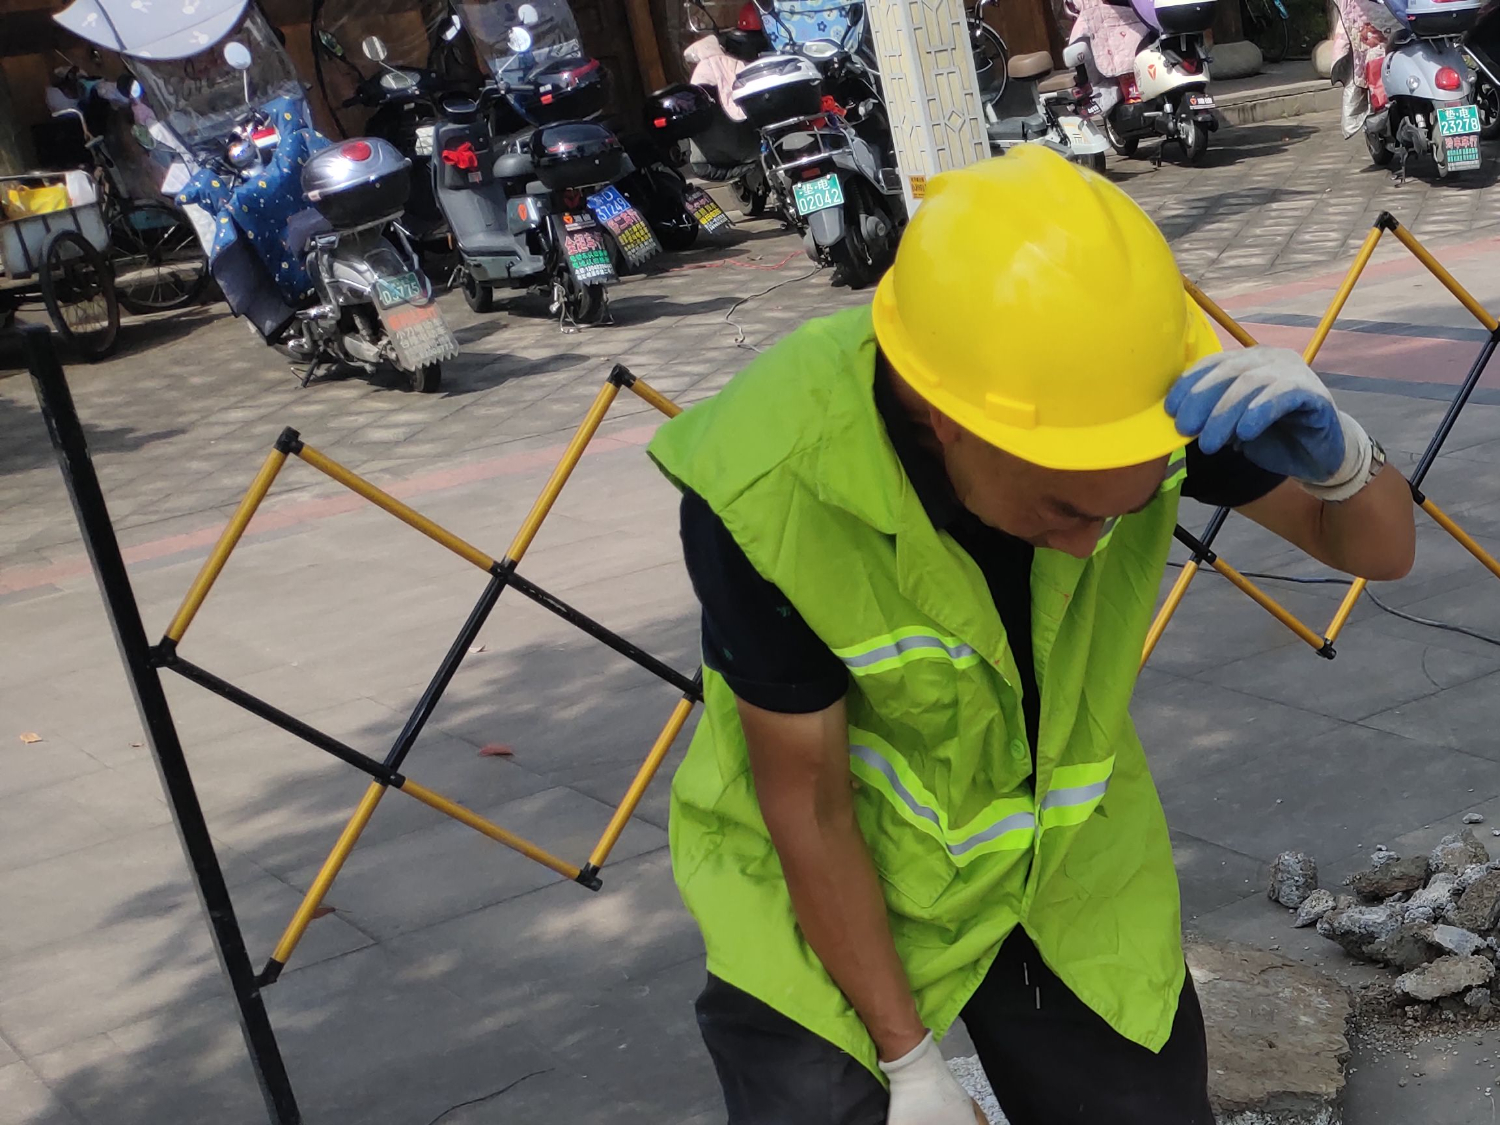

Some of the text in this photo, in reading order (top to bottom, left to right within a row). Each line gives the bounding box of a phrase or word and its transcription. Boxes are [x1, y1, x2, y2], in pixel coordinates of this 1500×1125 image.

[1442, 118, 1478, 133] 23278
[596, 198, 627, 220] 37249
[799, 188, 840, 211] 02042
